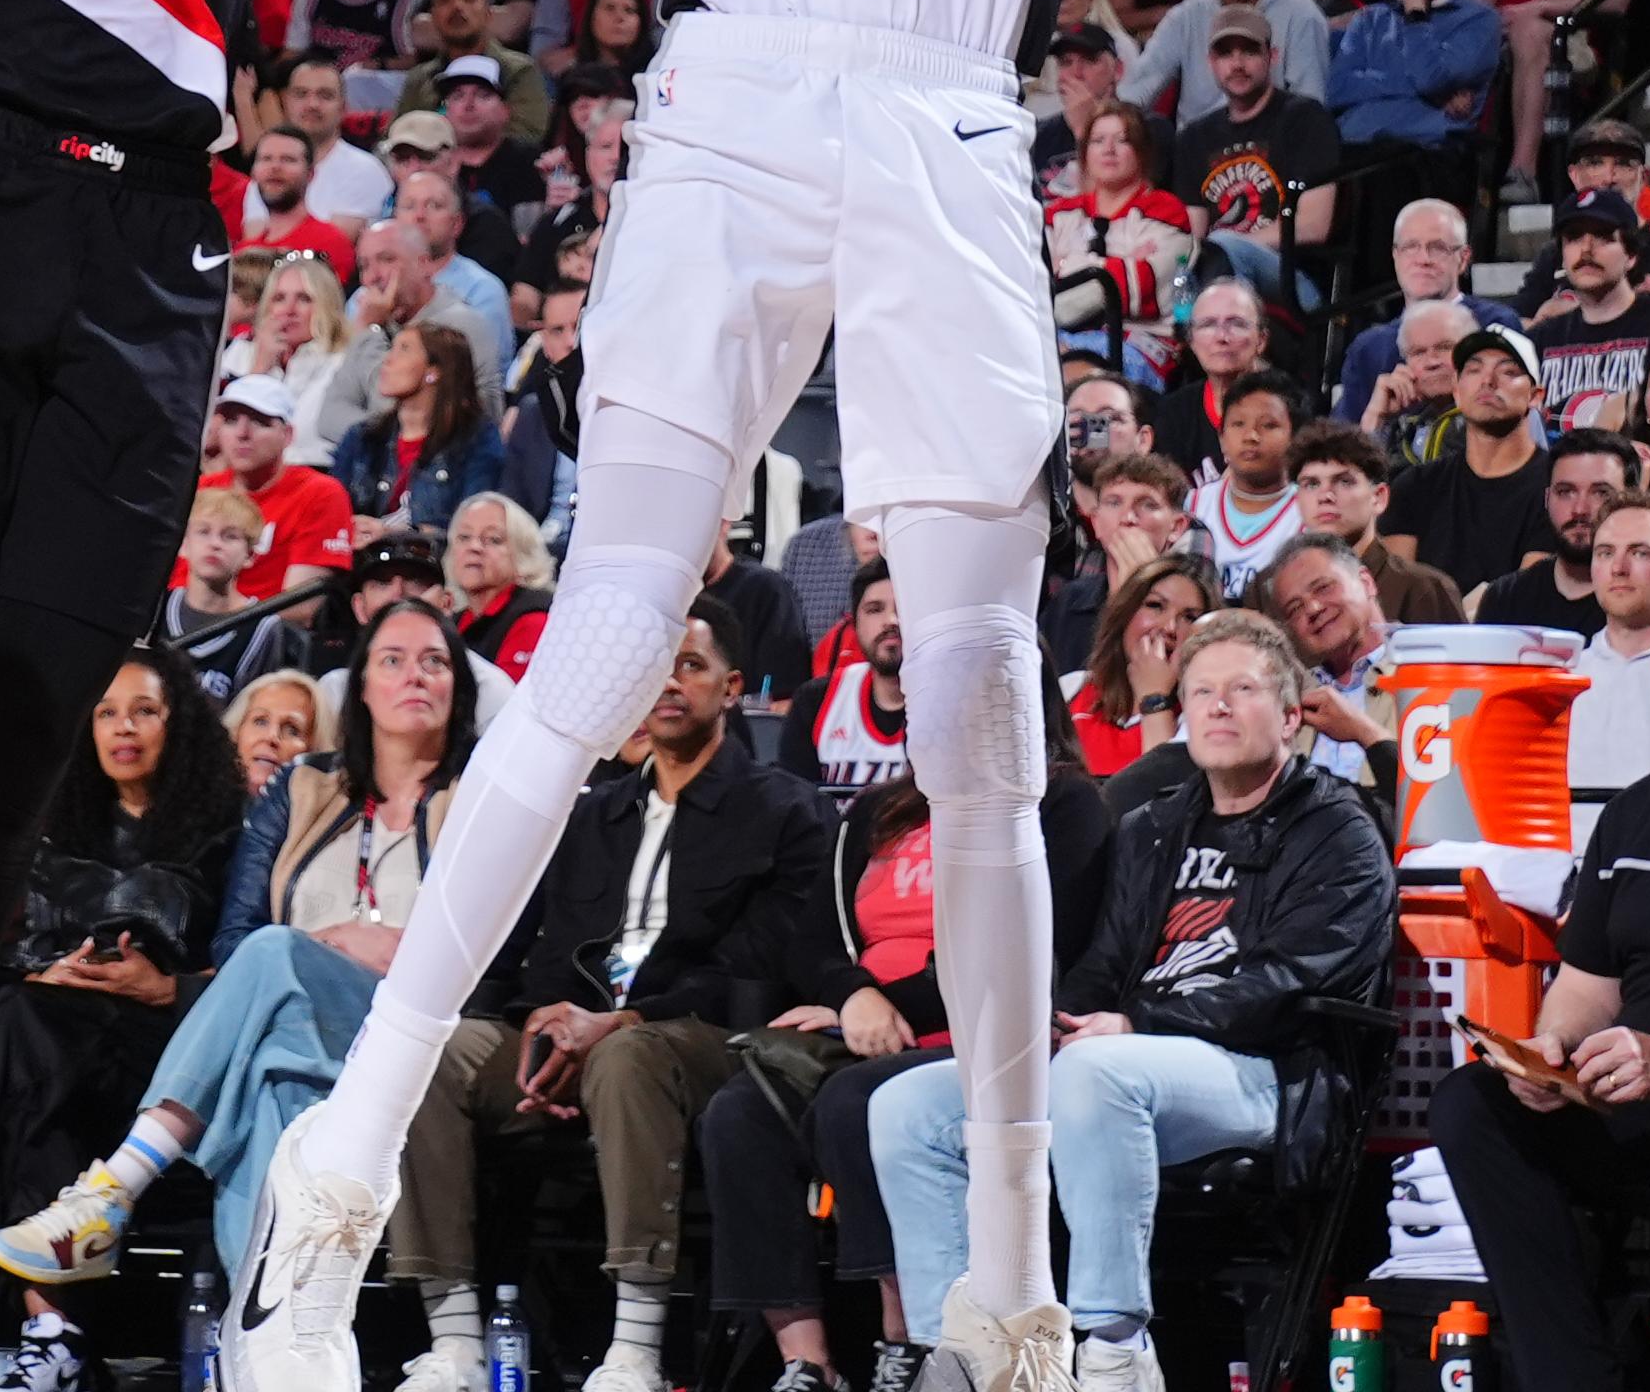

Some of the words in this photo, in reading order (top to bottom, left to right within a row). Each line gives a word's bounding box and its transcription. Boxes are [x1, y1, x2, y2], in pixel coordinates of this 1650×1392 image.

[59, 135, 126, 172] ripcity
[1400, 703, 1452, 783] G
[1329, 1356, 1355, 1392] G
[1441, 1358, 1473, 1392] G
